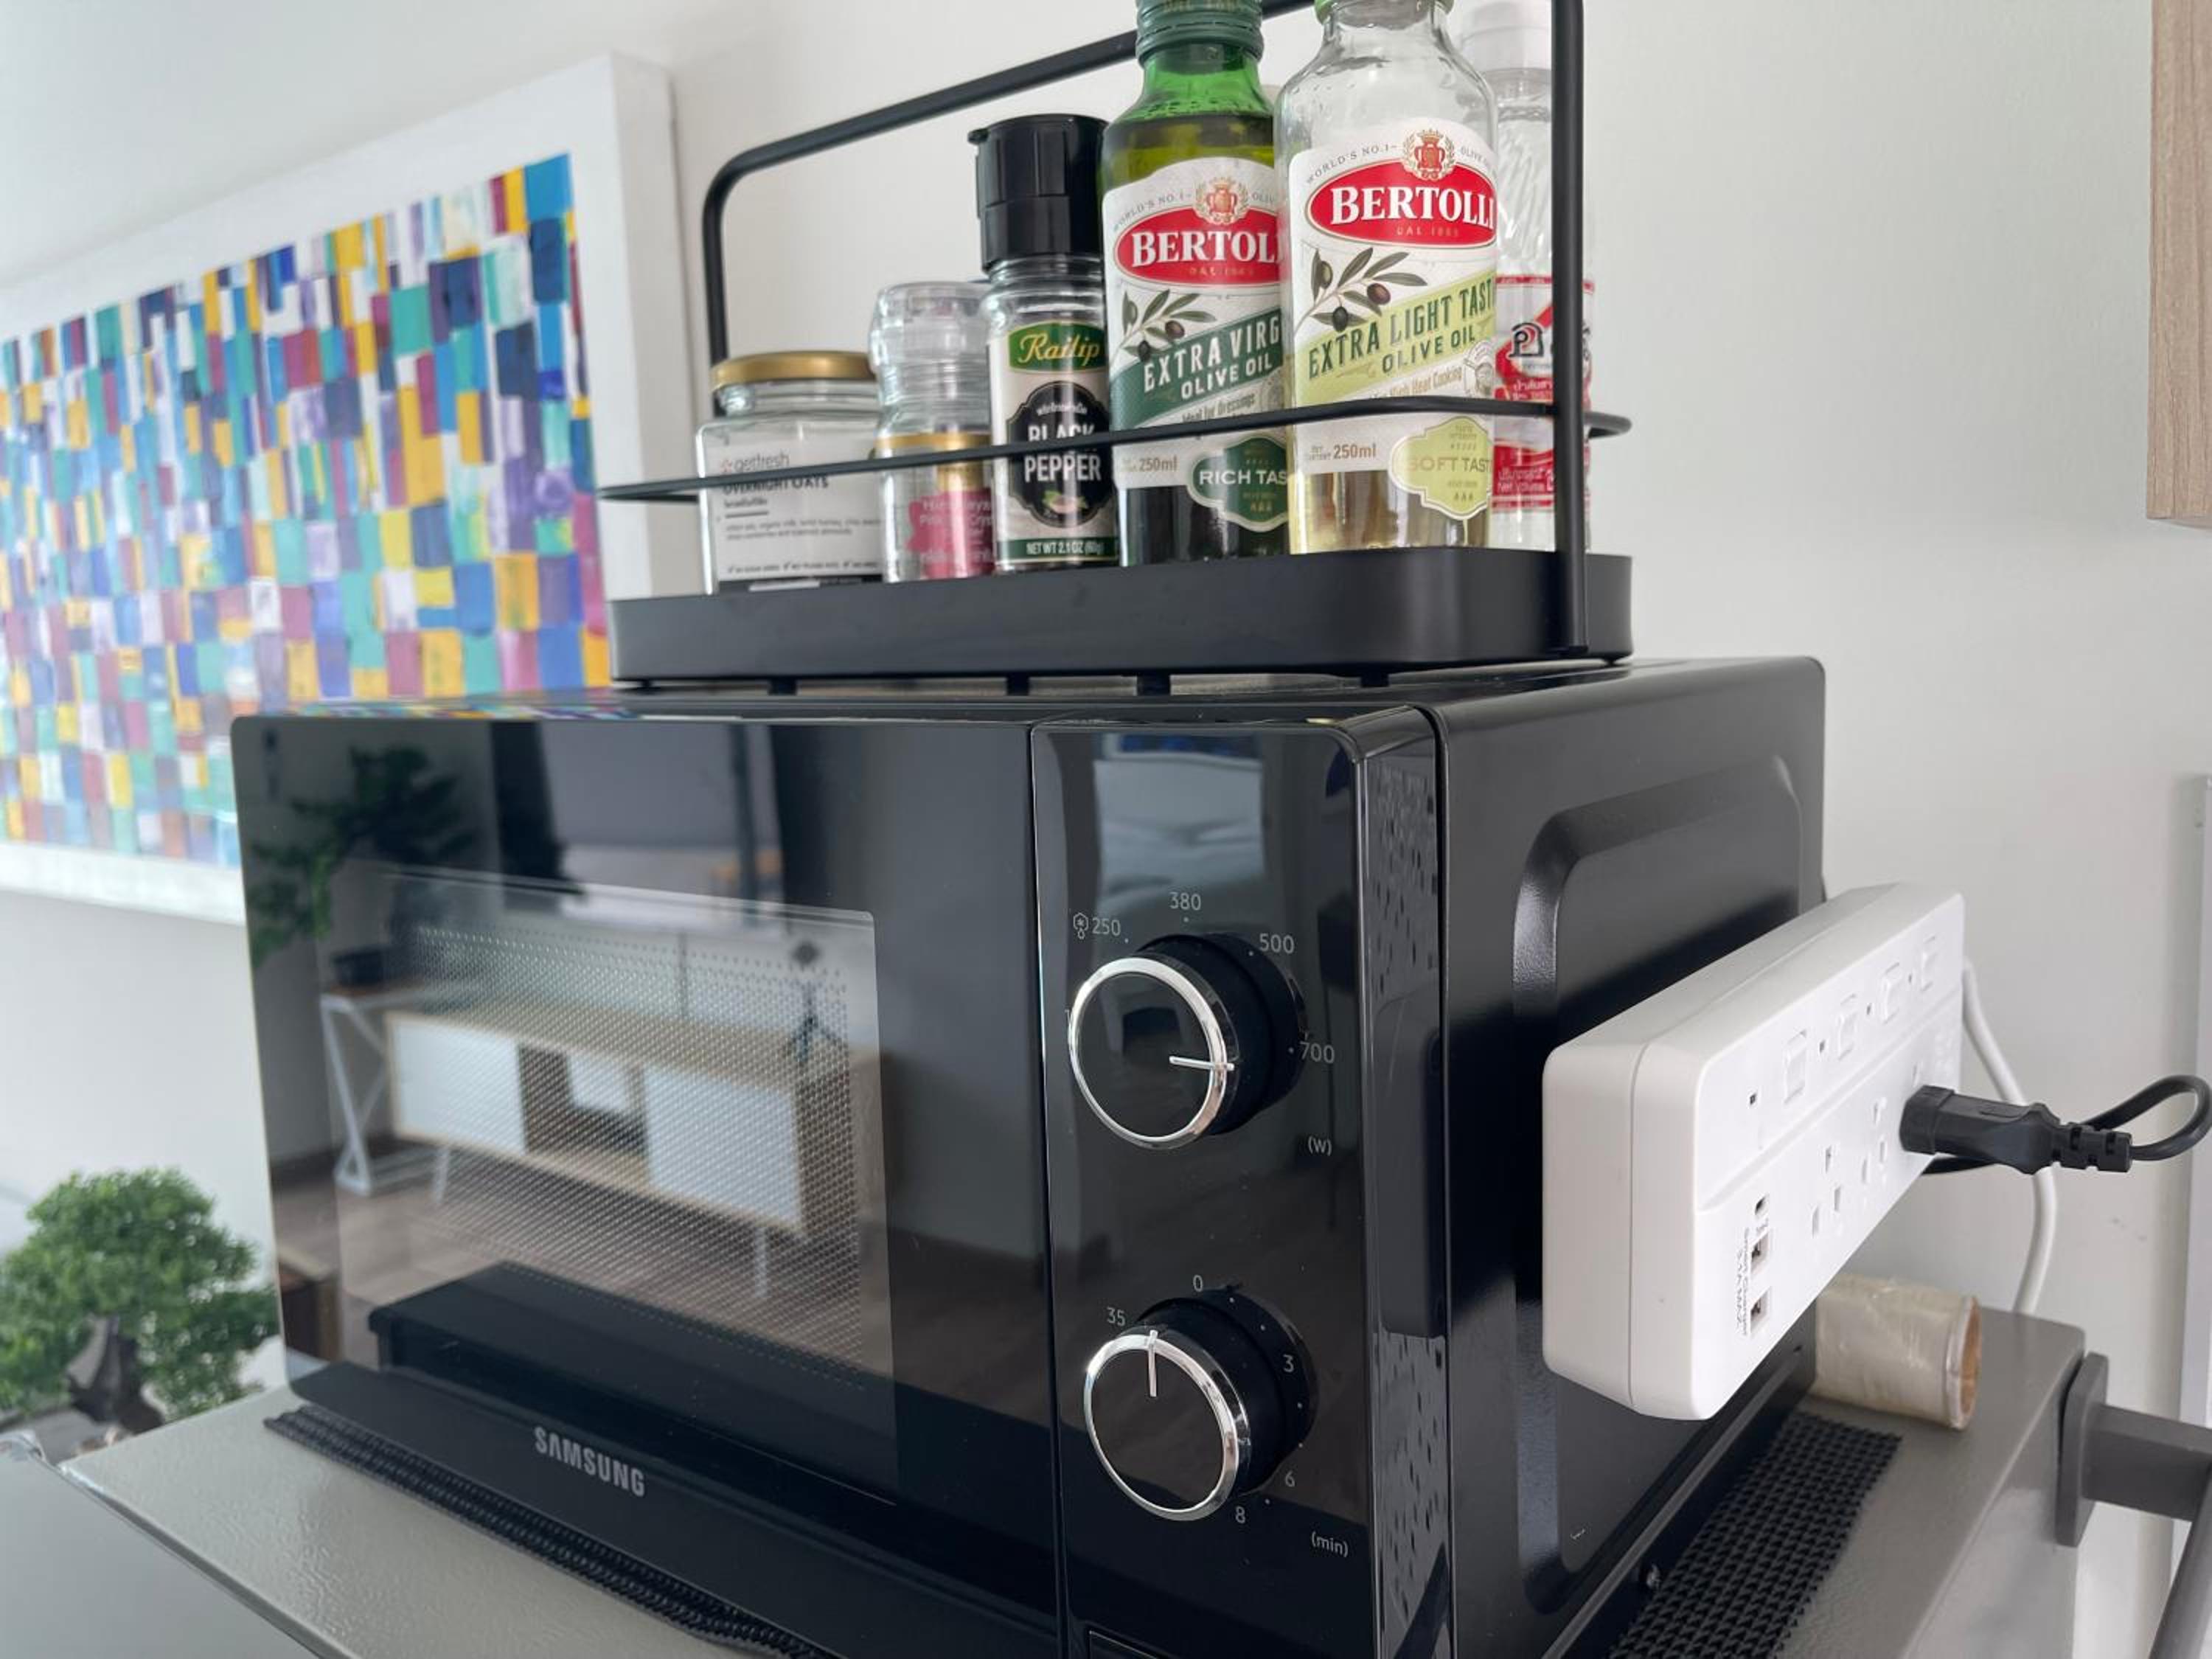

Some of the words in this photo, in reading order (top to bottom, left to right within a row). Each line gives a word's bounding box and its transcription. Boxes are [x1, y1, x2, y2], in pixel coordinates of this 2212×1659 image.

[1329, 186, 1495, 229] BERTOLLI
[1131, 230, 1276, 267] BERTOL
[1308, 320, 1380, 380] EXTRA
[1390, 295, 1452, 346] LIGHT
[1460, 278, 1495, 319] TAST
[1144, 336, 1222, 394] EXTRA
[1230, 316, 1279, 358] VIRG
[1382, 335, 1444, 374] OLIVE
[1451, 324, 1475, 348] OIL
[1181, 363, 1239, 399] OLIVE
[1246, 352, 1273, 377] OIL
[1333, 442, 1377, 459] 250ml
[1024, 454, 1102, 483] PEPPER
[1138, 456, 1178, 471] 250ml
[1461, 456, 1493, 473] TAST
[1199, 470, 1251, 485] RICH
[1256, 470, 1287, 485] TAS
[1169, 892, 1201, 911] 380
[1091, 917, 1121, 936] 250
[1258, 934, 1295, 954] 500
[1300, 1041, 1335, 1064] 700
[1307, 1135, 1332, 1157] (W)
[1192, 1274, 1204, 1293] 0
[1106, 1306, 1127, 1327] 35
[1283, 1353, 1295, 1373] 3
[533, 1426, 645, 1498] SAMSUNG
[1284, 1470, 1295, 1488] 6
[1235, 1505, 1246, 1524] 8
[1310, 1530, 1349, 1558] (min)
